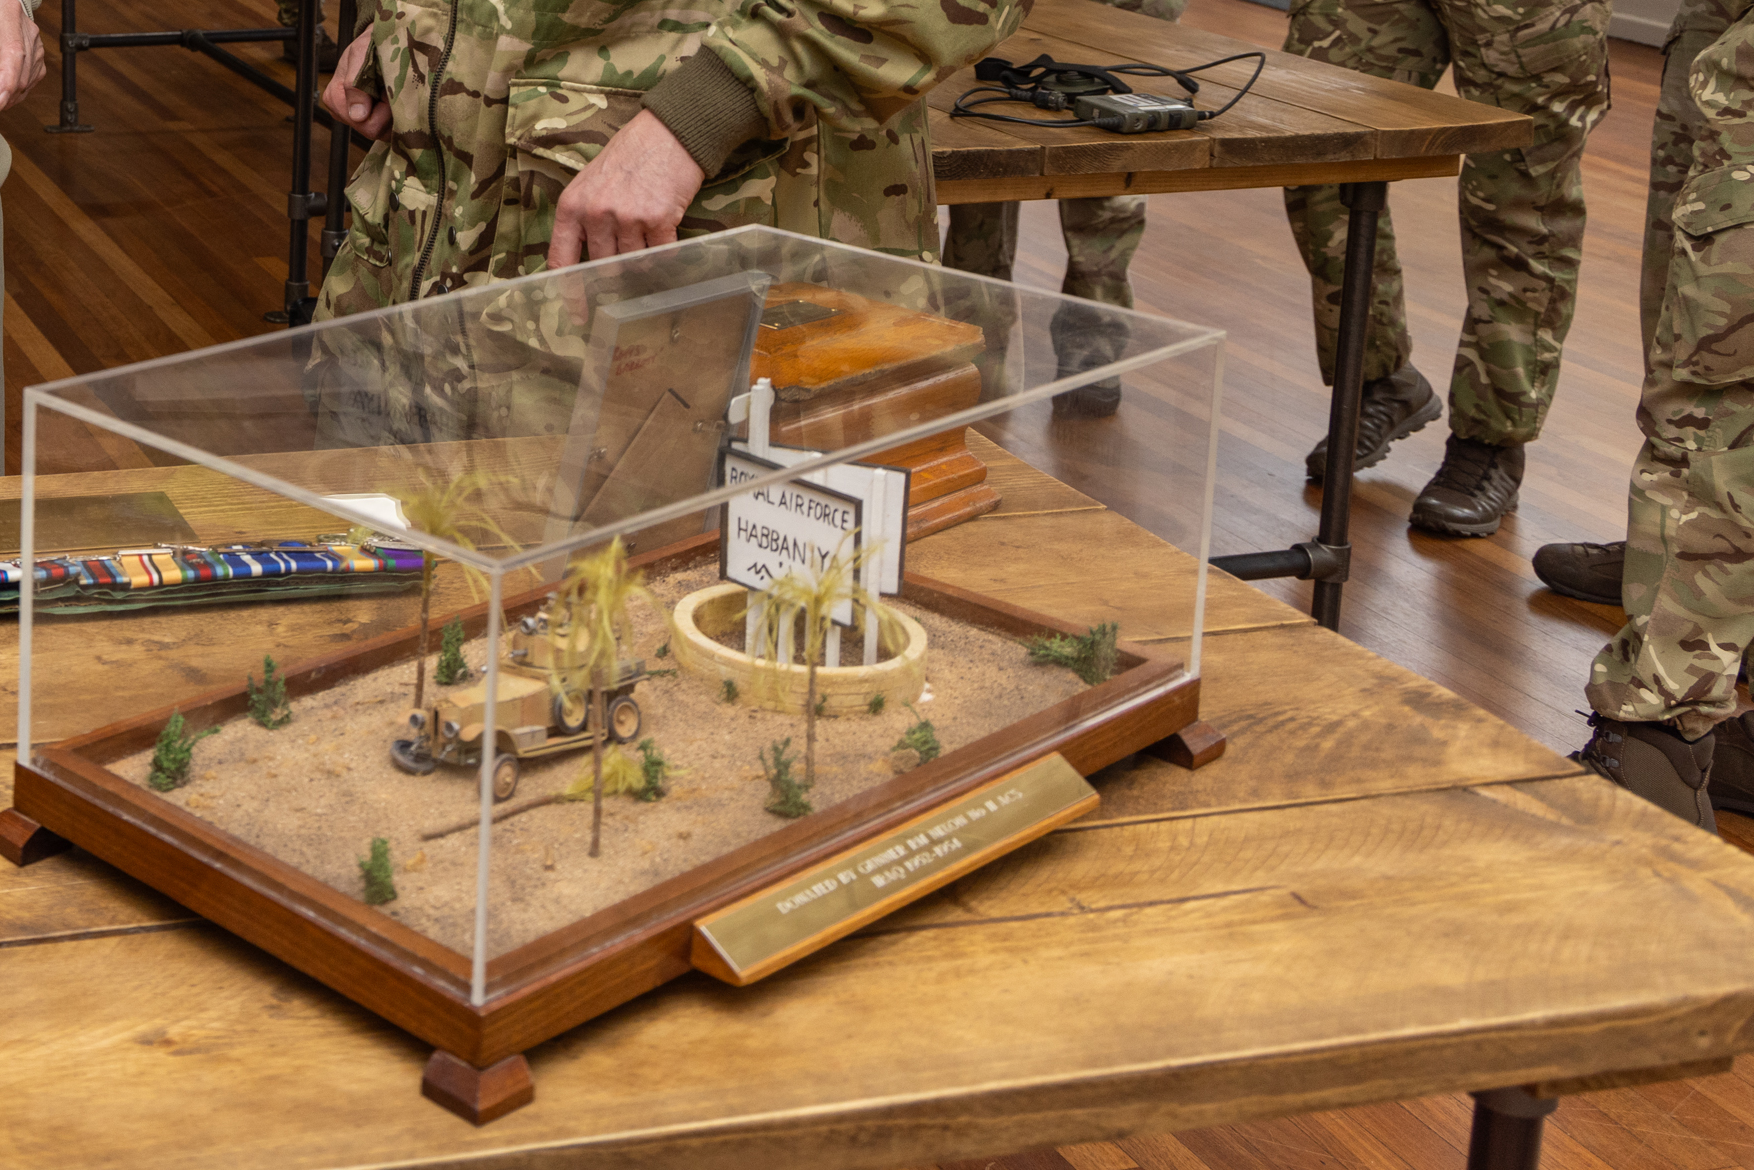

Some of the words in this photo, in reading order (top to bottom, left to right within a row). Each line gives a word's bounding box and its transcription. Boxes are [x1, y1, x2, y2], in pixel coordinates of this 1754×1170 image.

[778, 490, 804, 515] AIR
[807, 498, 850, 530] FORCE
[776, 878, 838, 914] DONATED
[837, 868, 857, 885] BY
[857, 844, 908, 874] GUNNER
[871, 865, 906, 888] IRAQ
